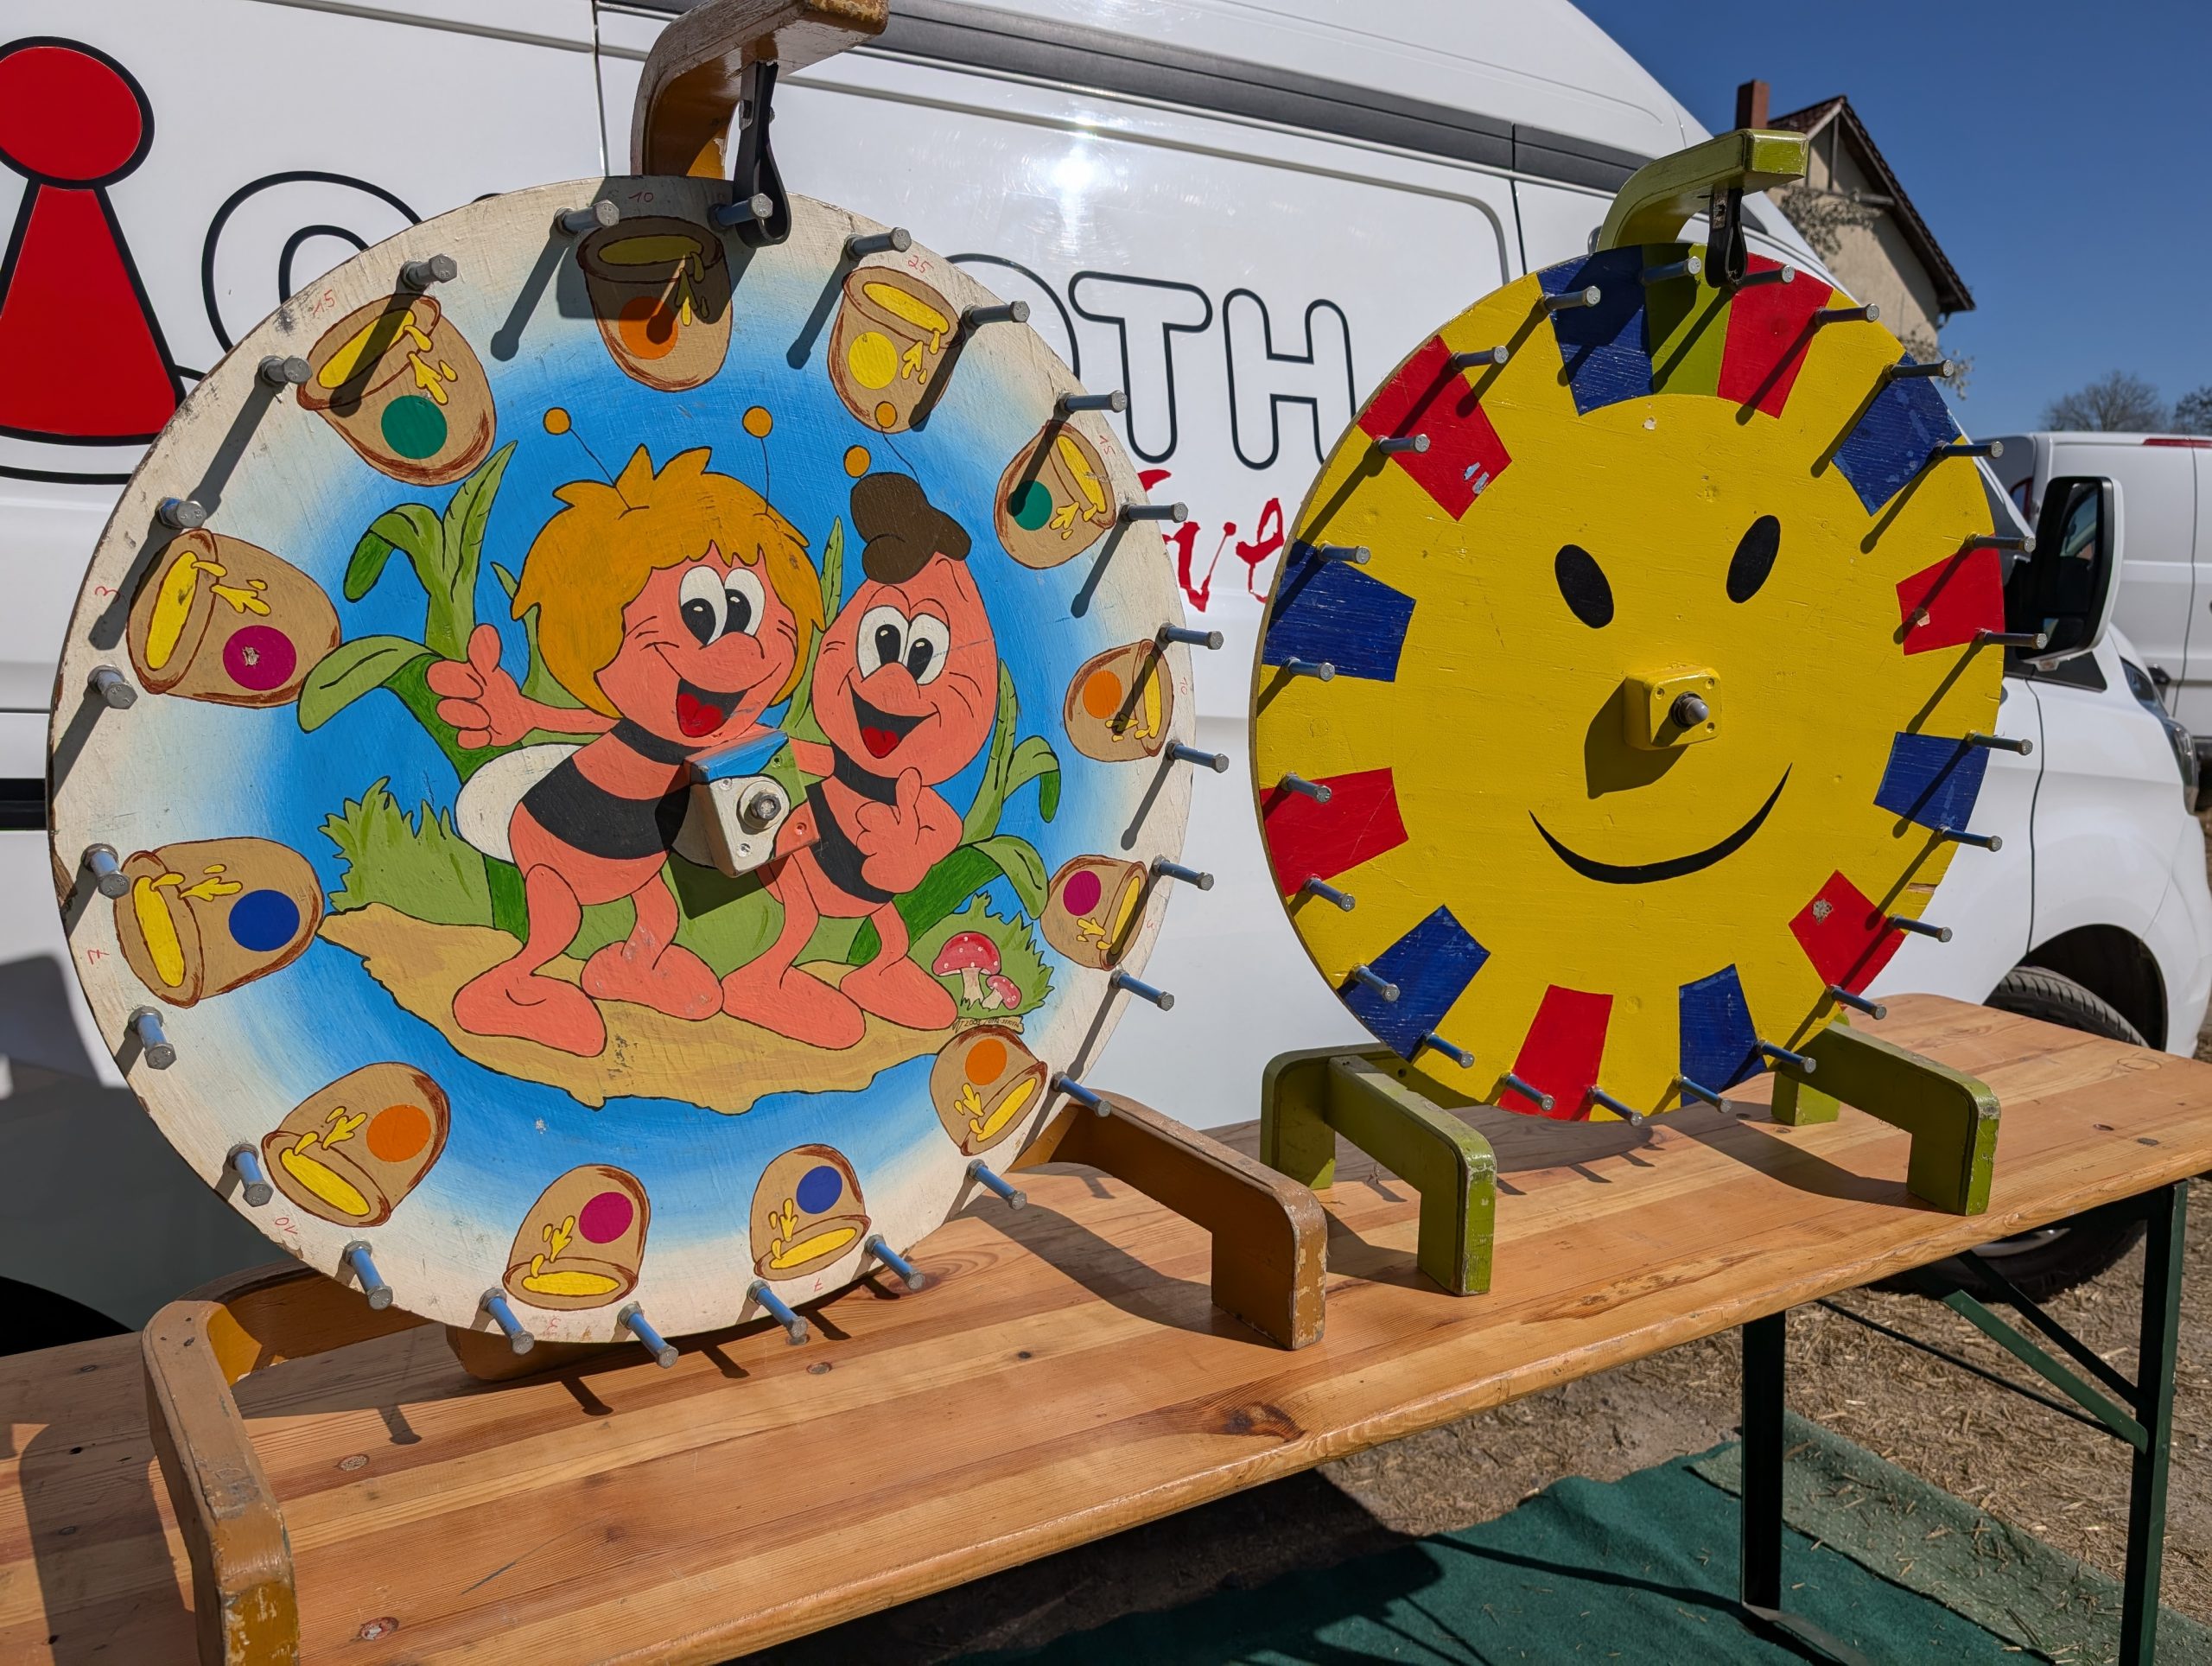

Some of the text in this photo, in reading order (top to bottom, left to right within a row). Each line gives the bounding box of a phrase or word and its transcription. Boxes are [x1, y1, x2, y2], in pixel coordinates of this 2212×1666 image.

[628, 191, 654, 203] 10
[907, 255, 934, 273] 25
[312, 289, 335, 317] 15
[1099, 435, 1116, 458] 15
[1179, 677, 1188, 696] 10
[87, 949, 110, 965] 7
[275, 1217, 298, 1235] 10
